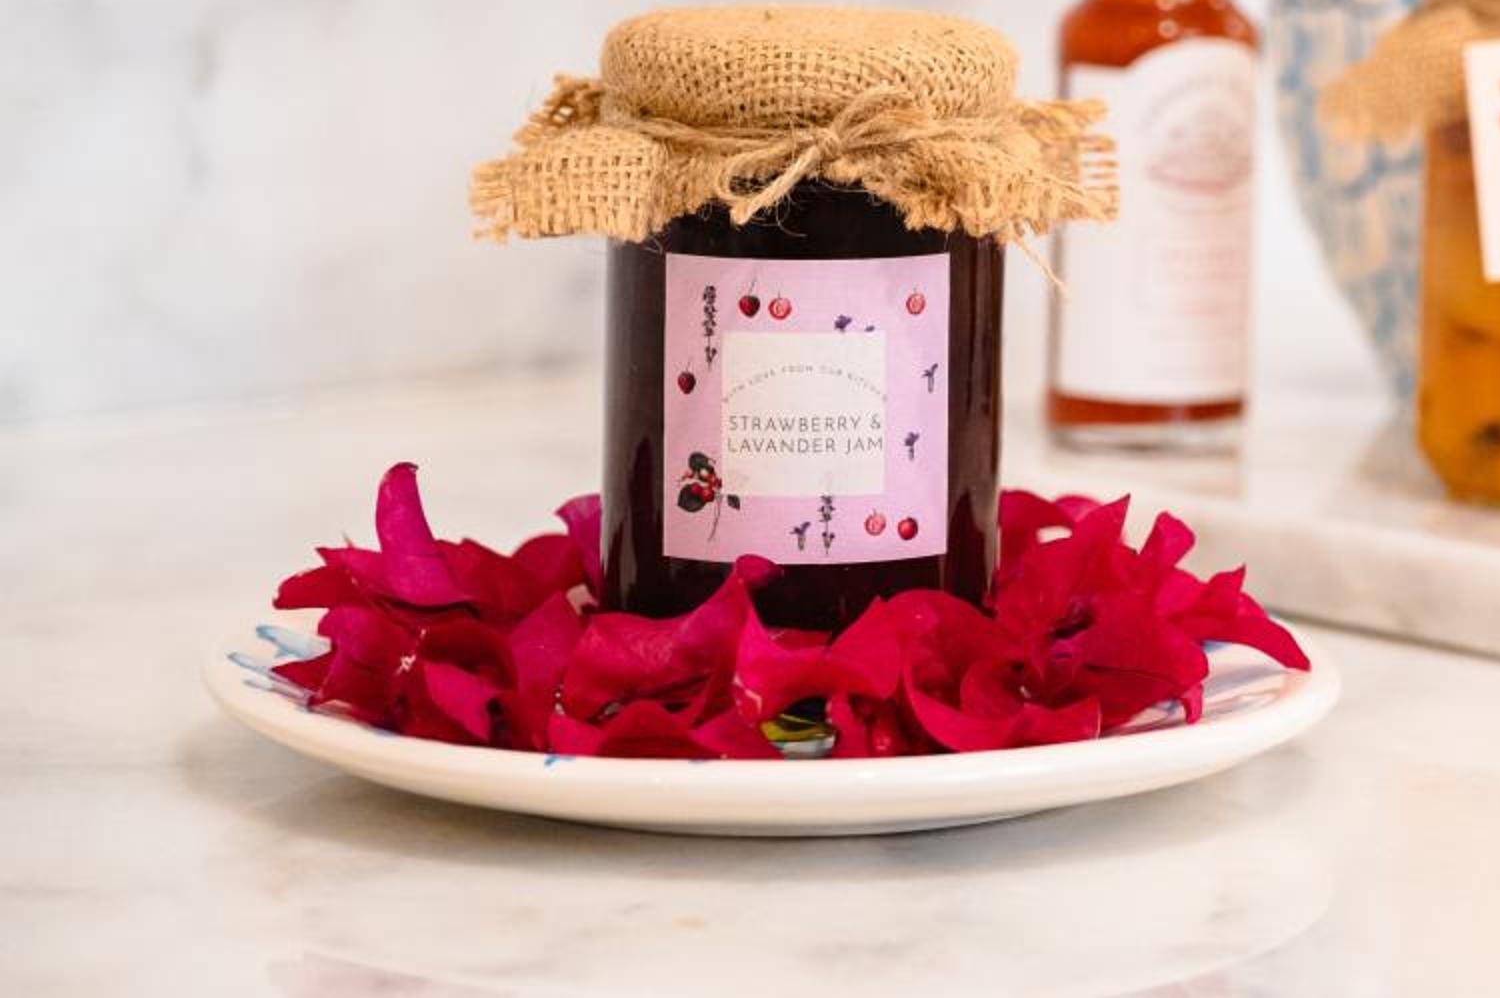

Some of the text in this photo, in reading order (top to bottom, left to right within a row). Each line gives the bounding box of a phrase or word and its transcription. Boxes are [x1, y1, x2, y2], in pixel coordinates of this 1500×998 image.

[781, 364, 814, 374] FROM
[728, 413, 881, 433] STRAWBERRY &
[727, 437, 883, 454] LAVANDER JAM
